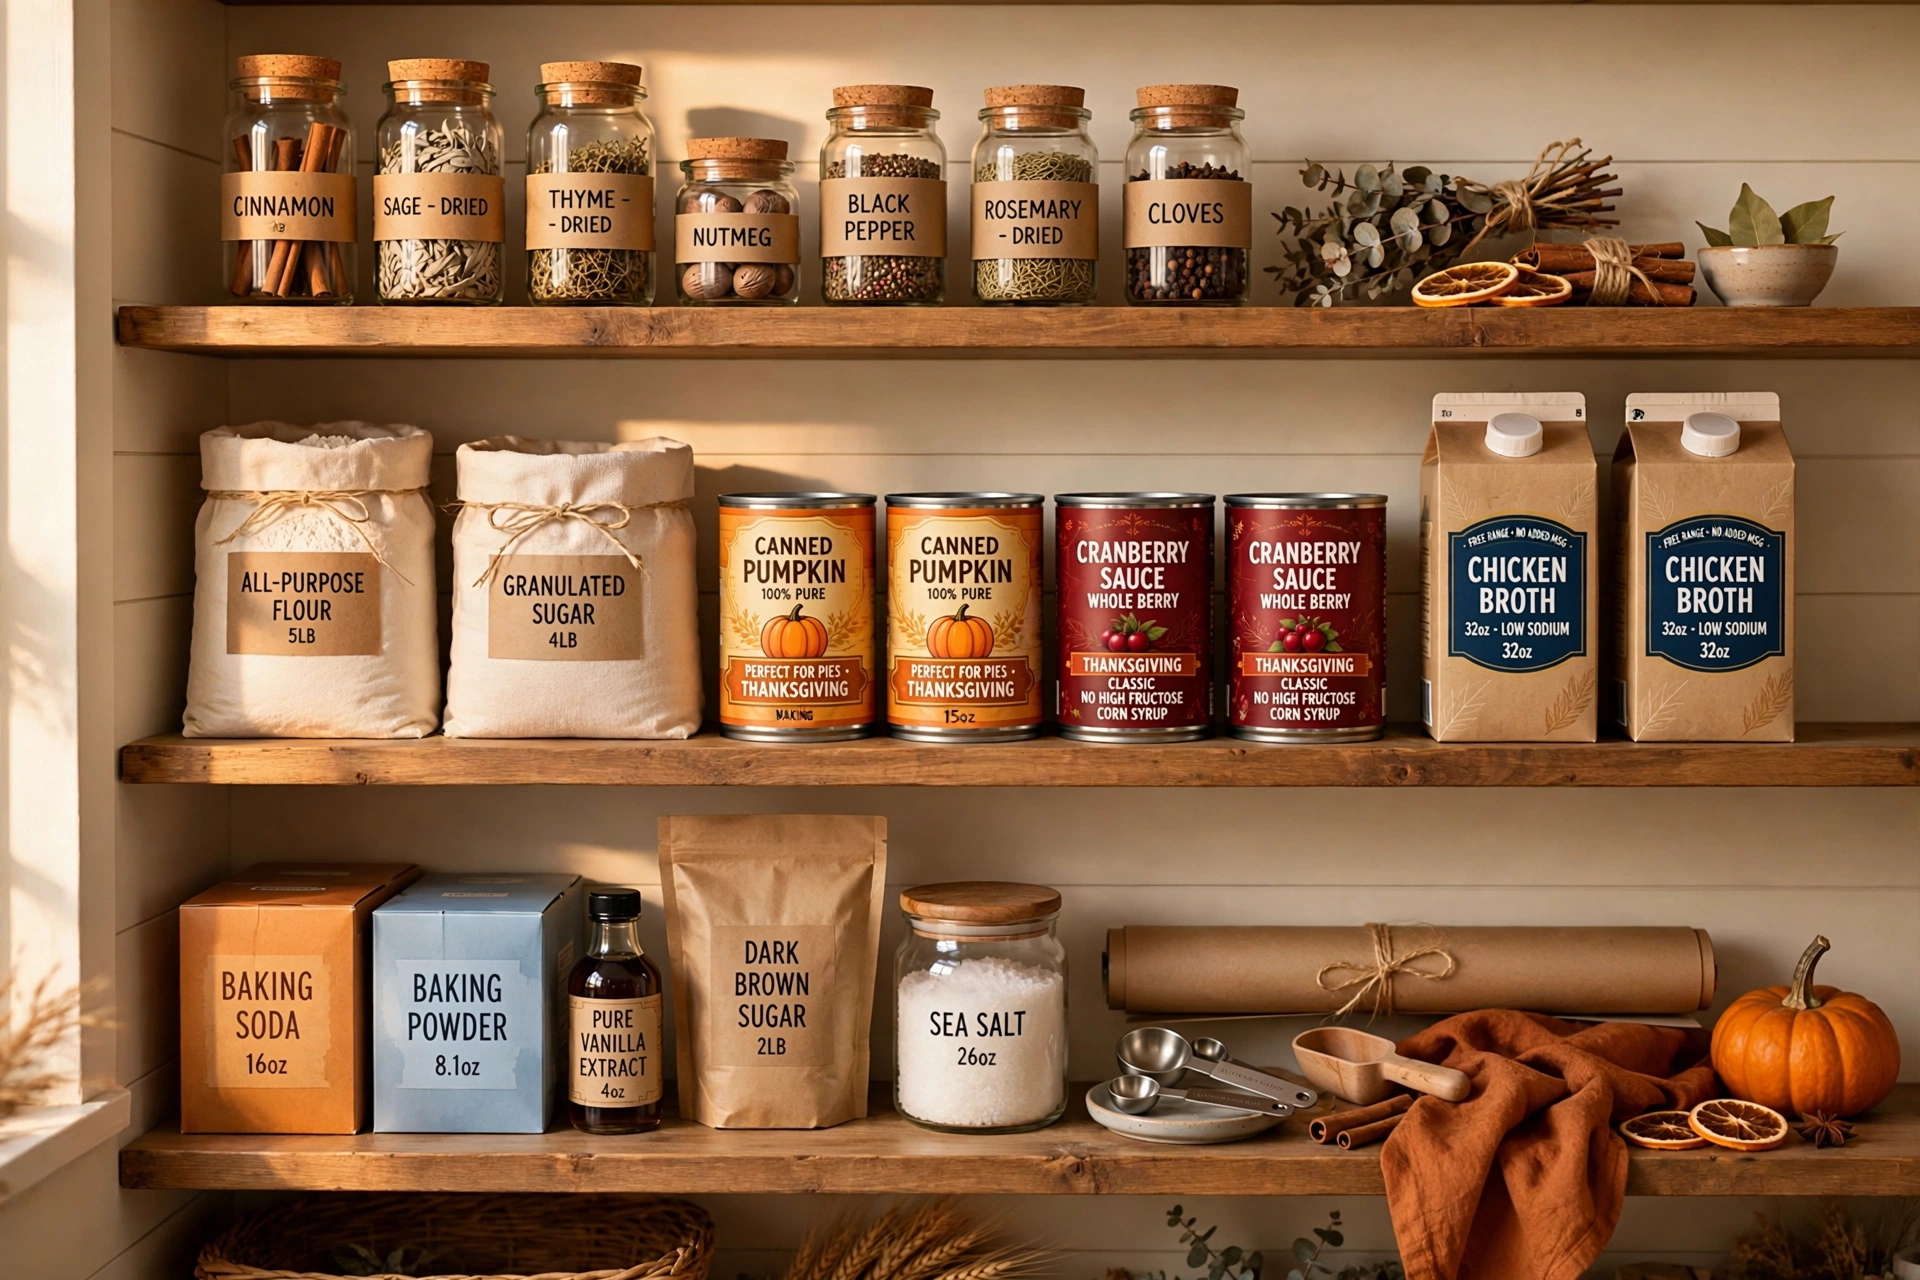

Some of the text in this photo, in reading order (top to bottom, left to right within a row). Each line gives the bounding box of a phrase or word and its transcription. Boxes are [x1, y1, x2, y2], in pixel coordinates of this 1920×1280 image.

[233, 196, 335, 217] CINNAMON
[383, 197, 421, 216] SAGE
[441, 197, 488, 216] DRIED
[549, 189, 615, 209] THYME
[848, 194, 910, 215] BLACK
[985, 200, 1082, 220] ROSEMARY
[1148, 203, 1224, 225] CLOVES
[561, 216, 613, 234] DRIED
[845, 221, 915, 242] PEPPER
[693, 227, 772, 247] NUTMEG
[1012, 226, 1063, 245] DRIED
[755, 537, 832, 555] CANNED
[921, 537, 999, 555] CANNED
[1468, 533, 1487, 548] FREE
[1550, 533, 1568, 548] MSG
[1663, 533, 1681, 548] FREE
[1747, 533, 1765, 548] MSG
[1077, 540, 1189, 564] CRANBERRY
[1249, 541, 1361, 564] CRANBERRY
[743, 559, 846, 583] PUMPKIN
[910, 559, 1012, 583] PUMPKIN
[1100, 567, 1165, 589] SAUCE
[1272, 567, 1336, 590] SAUCE
[1467, 556, 1566, 583] CHICKEN
[1665, 556, 1764, 582] CHICKEN
[241, 572, 365, 593] ALL-PURPOSE
[503, 575, 625, 597] GRANULATED
[761, 588, 825, 600] 100% PURE
[927, 588, 992, 600] 100% PURE
[1086, 593, 1179, 608] WHOLE BERRY
[1259, 593, 1350, 609] WHOLE BERRY
[1479, 587, 1555, 613] BROTH
[1677, 587, 1752, 613] BROTH
[272, 600, 331, 620] FLOUR
[532, 603, 595, 625] SUGAR
[288, 628, 315, 643] 5LB
[1464, 622, 1490, 636] 32oz
[1501, 622, 1524, 636] LOW
[1527, 622, 1569, 635] SODIUM
[1661, 621, 1687, 635] 32oz
[1698, 622, 1722, 635] LOW
[1724, 622, 1766, 635] SODIUM
[548, 632, 577, 648] 4LB
[1501, 642, 1532, 658] 32oz
[1699, 642, 1729, 658] 32oz
[744, 664, 790, 678] PERFECT
[793, 666, 814, 678] FOR
[817, 665, 840, 678] PIES
[910, 664, 955, 678] PERFECT
[958, 665, 981, 678] FOR
[984, 665, 1007, 678] PIES
[1083, 657, 1182, 673] THANKSGIVING
[1255, 658, 1354, 673] THANKSGIVING
[741, 680, 849, 698] THANKSGIVING
[907, 680, 1014, 698] THANKSGIVING
[1107, 677, 1155, 689] CLASSIC
[1280, 678, 1327, 690] CLASSIC
[1081, 691, 1183, 705] NO HIGH FRUCTOSE
[1253, 692, 1355, 705] NO HIGH FRUCTOSE
[944, 710, 976, 723] 15oz
[1096, 707, 1167, 720] CORN SYRUP
[1269, 707, 1340, 721] CORN SYRUP
[745, 941, 799, 964] DARK
[222, 971, 312, 1000] BAKING
[413, 974, 501, 1002] BAKING
[735, 972, 809, 996] BROWN
[235, 1010, 299, 1039] SODA
[593, 1009, 633, 1028] PURE
[737, 1004, 806, 1028] SUGAR
[929, 1011, 1026, 1037] SEA SALT
[408, 1012, 507, 1041] POWDER
[581, 1033, 646, 1054] VANILLA
[757, 1037, 786, 1055] 2LB
[246, 1053, 287, 1074] 16oz
[435, 1055, 480, 1075] 8.1oz
[957, 1047, 996, 1066] 26oz
[580, 1056, 648, 1077] EXTRACT
[600, 1083, 625, 1098] 4oz
